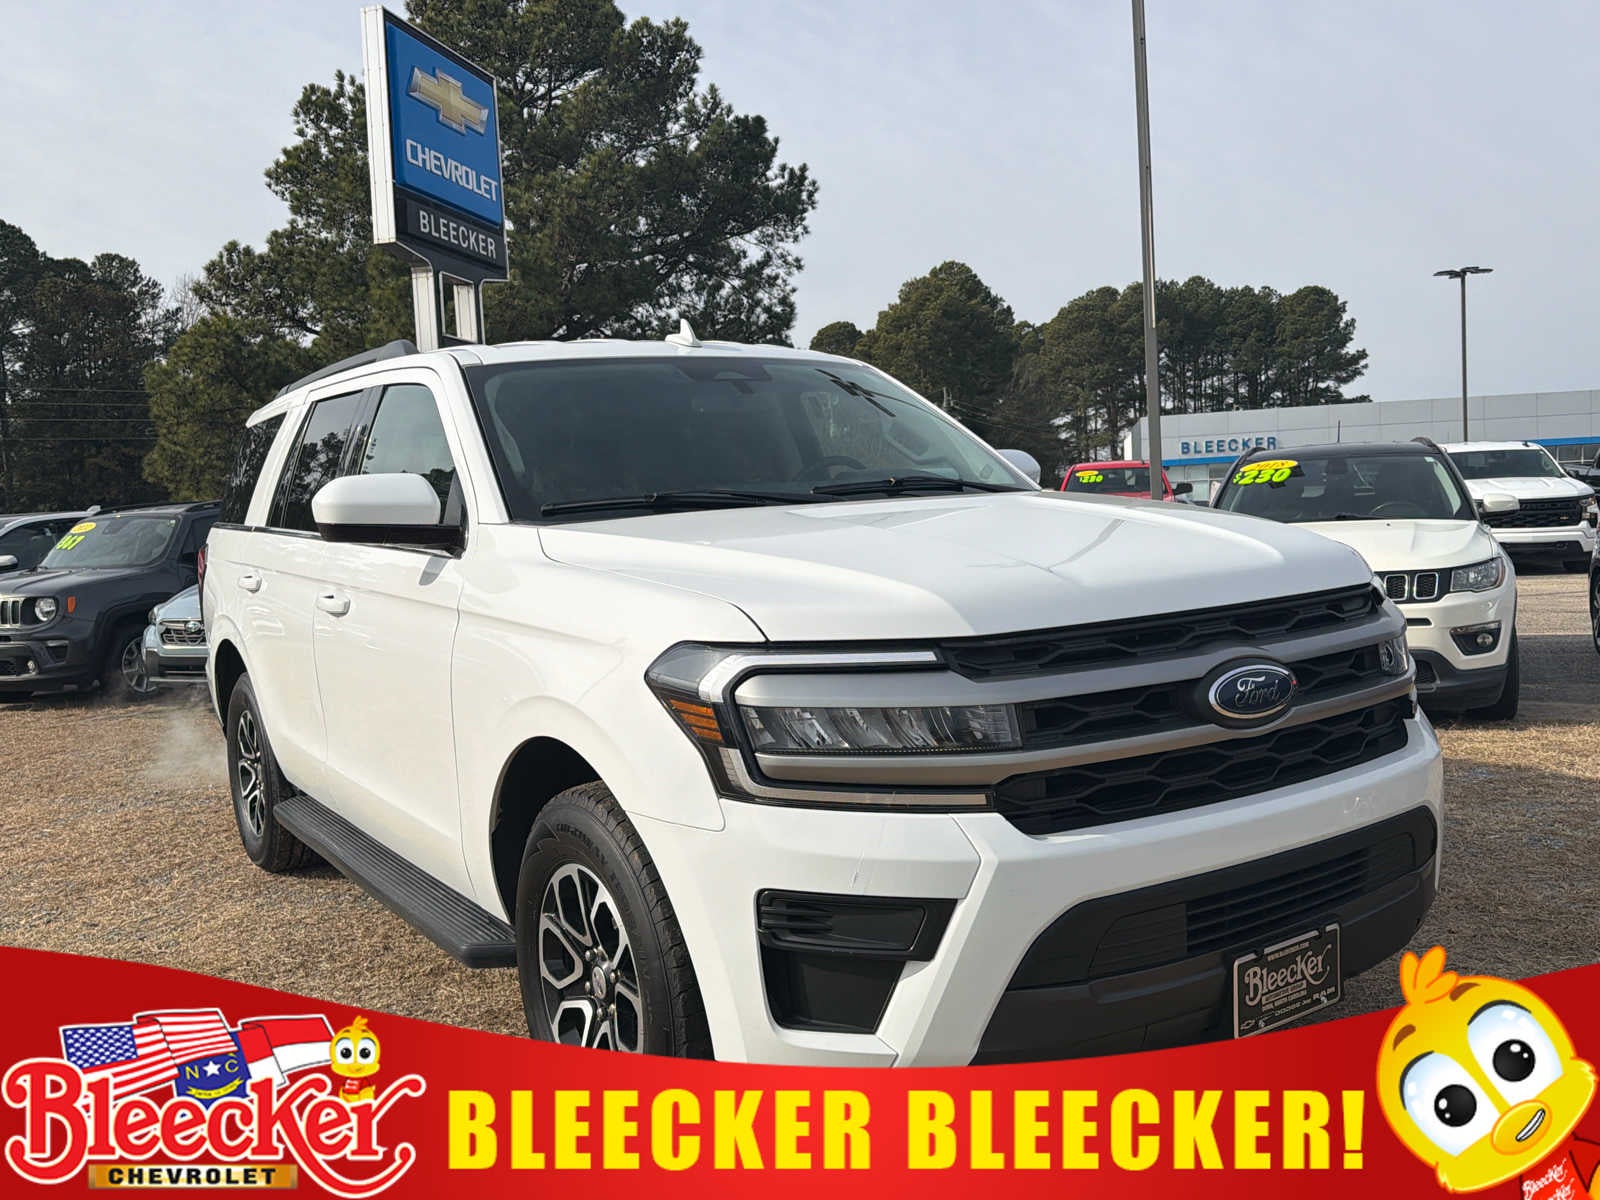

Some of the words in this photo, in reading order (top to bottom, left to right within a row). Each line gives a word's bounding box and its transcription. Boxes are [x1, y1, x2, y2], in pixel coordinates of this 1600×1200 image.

[406, 138, 498, 201] CHEVROLET
[419, 210, 496, 259] BLEECKER
[1181, 436, 1277, 454] BLEECKER
[1233, 468, 1292, 485] $230
[1235, 675, 1280, 708] Ford
[1244, 944, 1332, 1006] Bleecker
